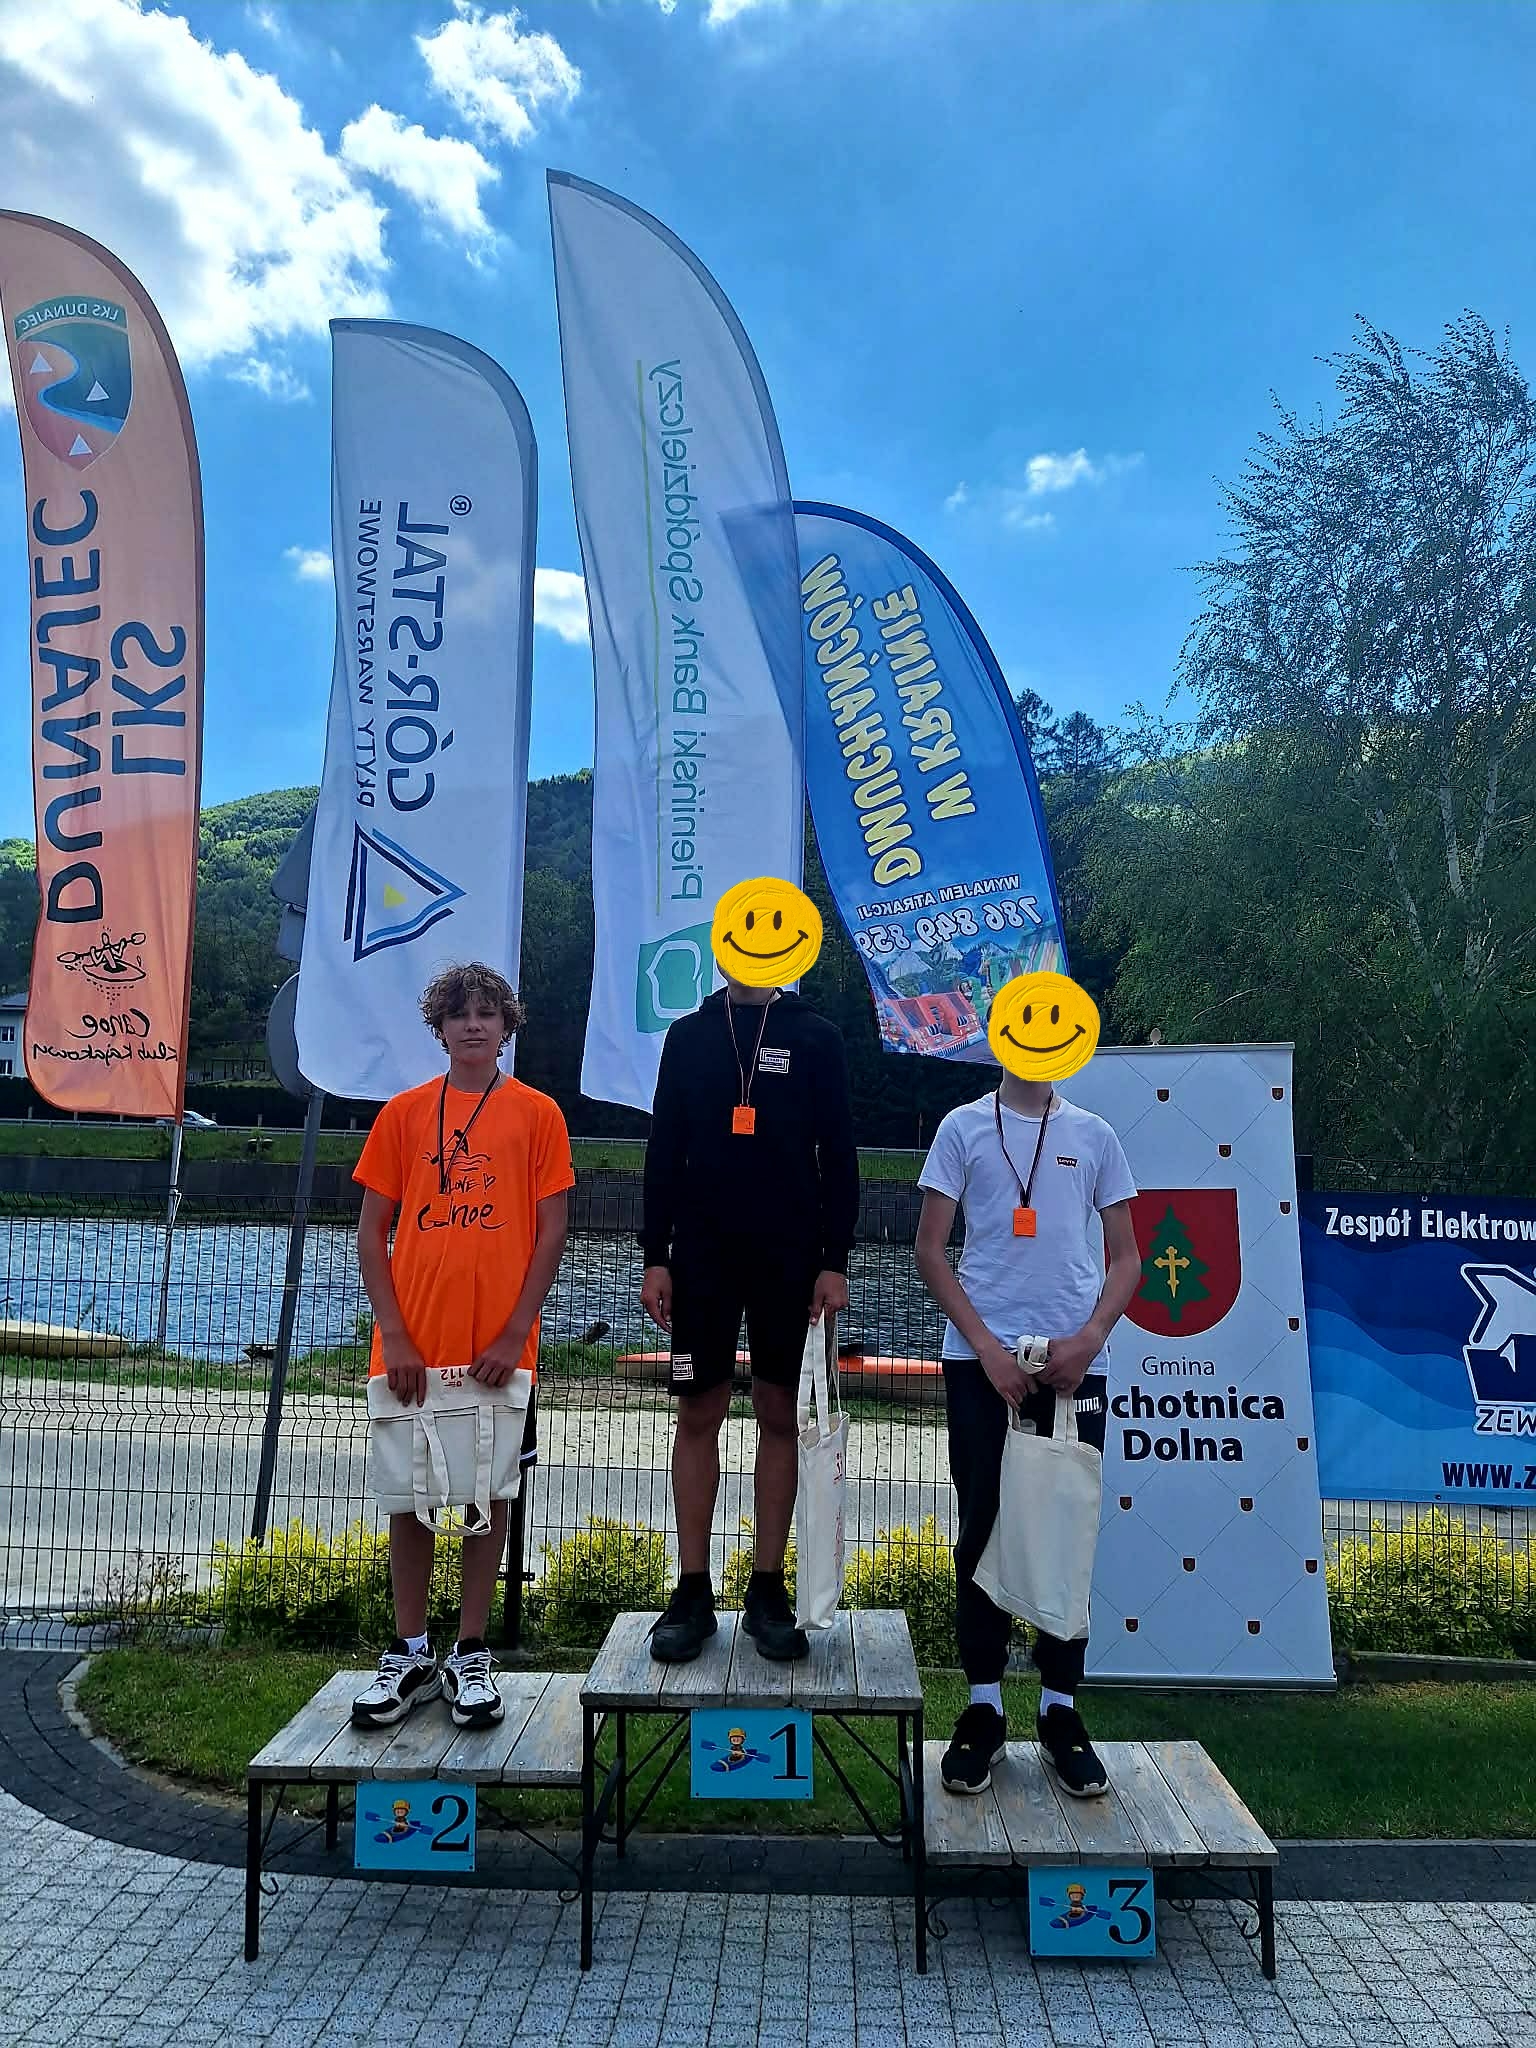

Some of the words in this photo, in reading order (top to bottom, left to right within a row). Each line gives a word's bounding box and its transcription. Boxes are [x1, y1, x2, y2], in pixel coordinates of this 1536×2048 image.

[1325, 1207, 1412, 1243] Zespół
[1421, 1209, 1536, 1241] Elektrow
[1141, 1355, 1216, 1376] Gmina
[1106, 1385, 1285, 1420] chotnica
[1122, 1428, 1244, 1462] Dolna
[768, 1722, 809, 1780] 1
[430, 1793, 471, 1853] 2
[1108, 1879, 1152, 1945] 3
